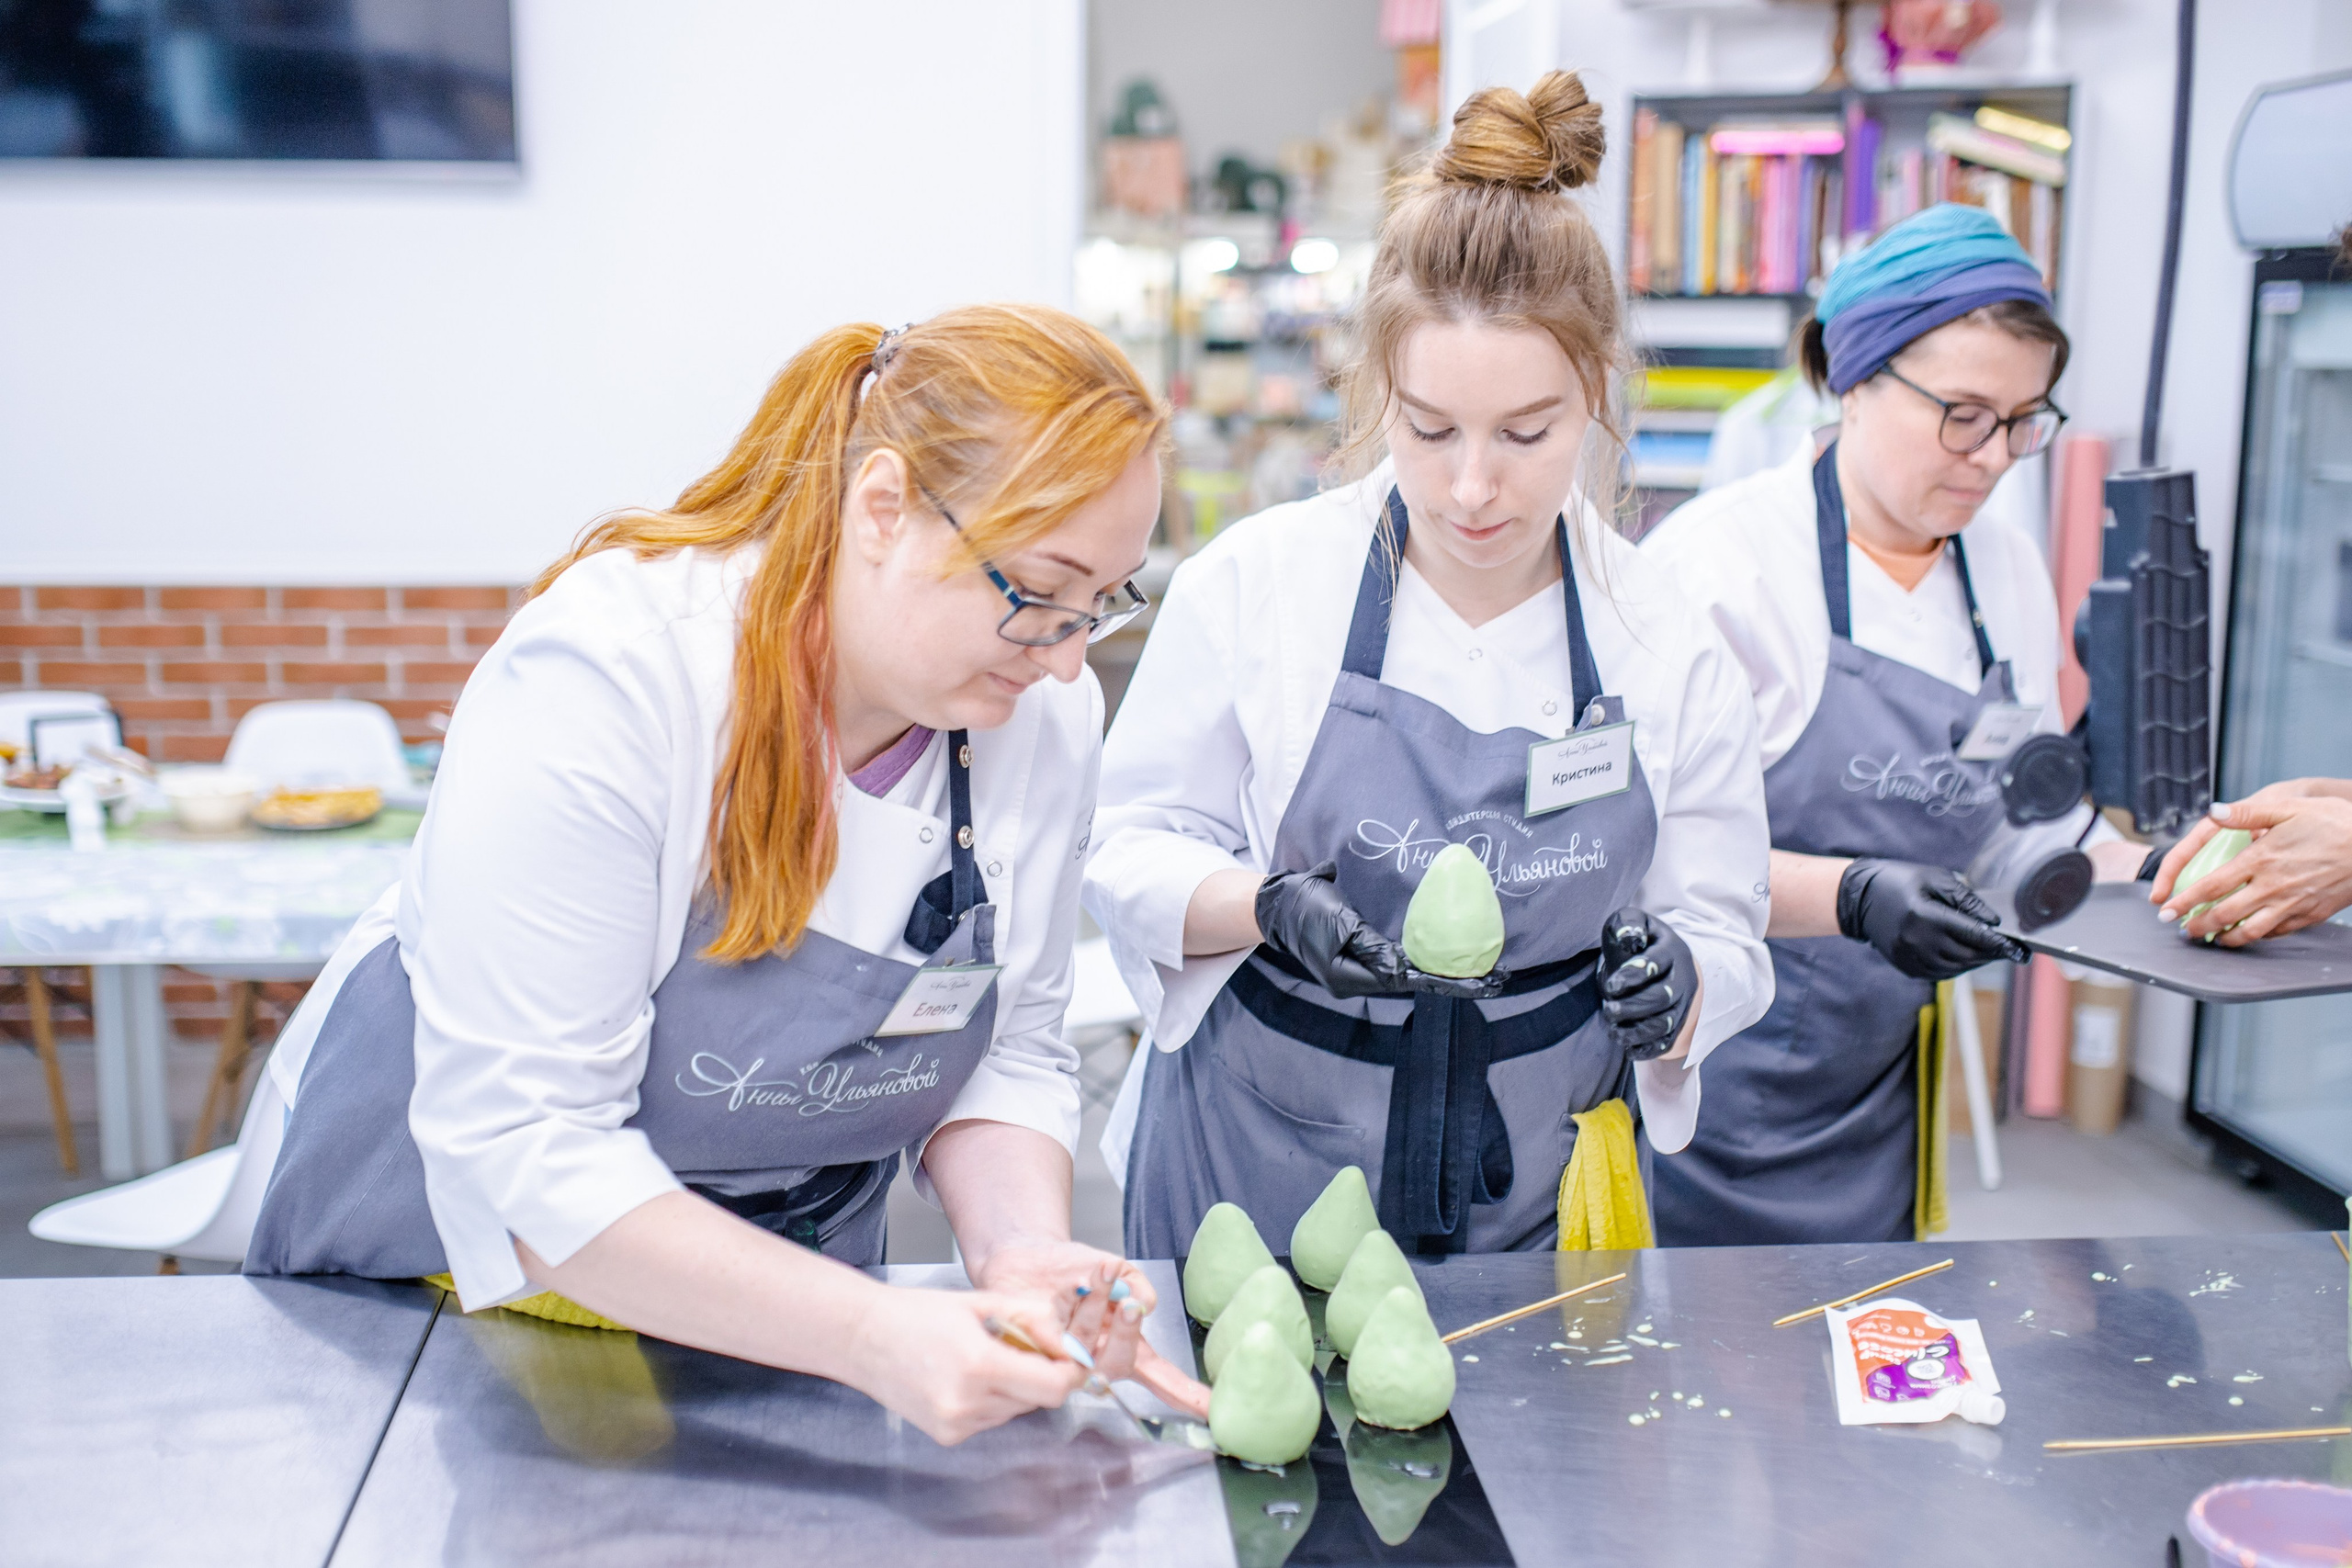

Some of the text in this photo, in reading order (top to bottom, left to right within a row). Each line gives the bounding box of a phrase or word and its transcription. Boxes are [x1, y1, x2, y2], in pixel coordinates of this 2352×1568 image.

[1551, 761, 1612, 786] Кристина
[912, 1001, 958, 1018] Елена
[852, 1038, 884, 1059] ТУДИЯ
[674, 1052, 941, 1118] Анны Ульяновой
